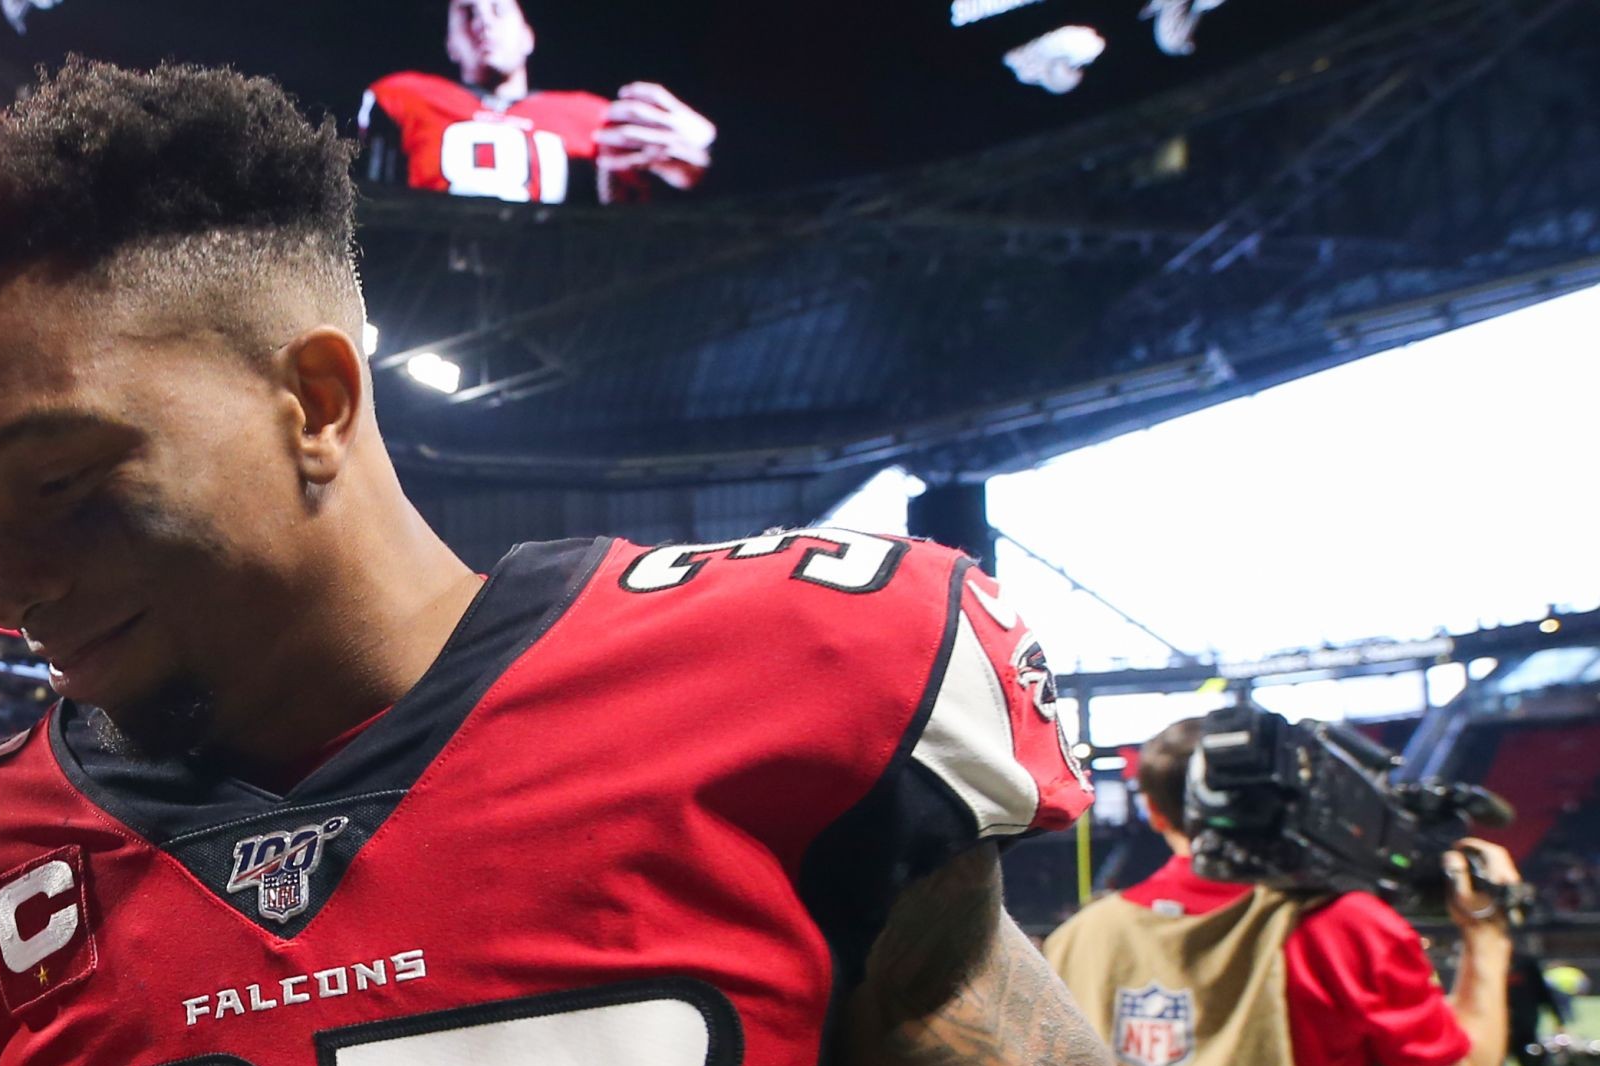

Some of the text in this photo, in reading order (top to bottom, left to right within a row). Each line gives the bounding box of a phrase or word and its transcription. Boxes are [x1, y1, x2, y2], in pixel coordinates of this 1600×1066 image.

[265, 886, 301, 909] NFL
[182, 949, 427, 1026] FALCONS
[1123, 1021, 1187, 1064] NFL
